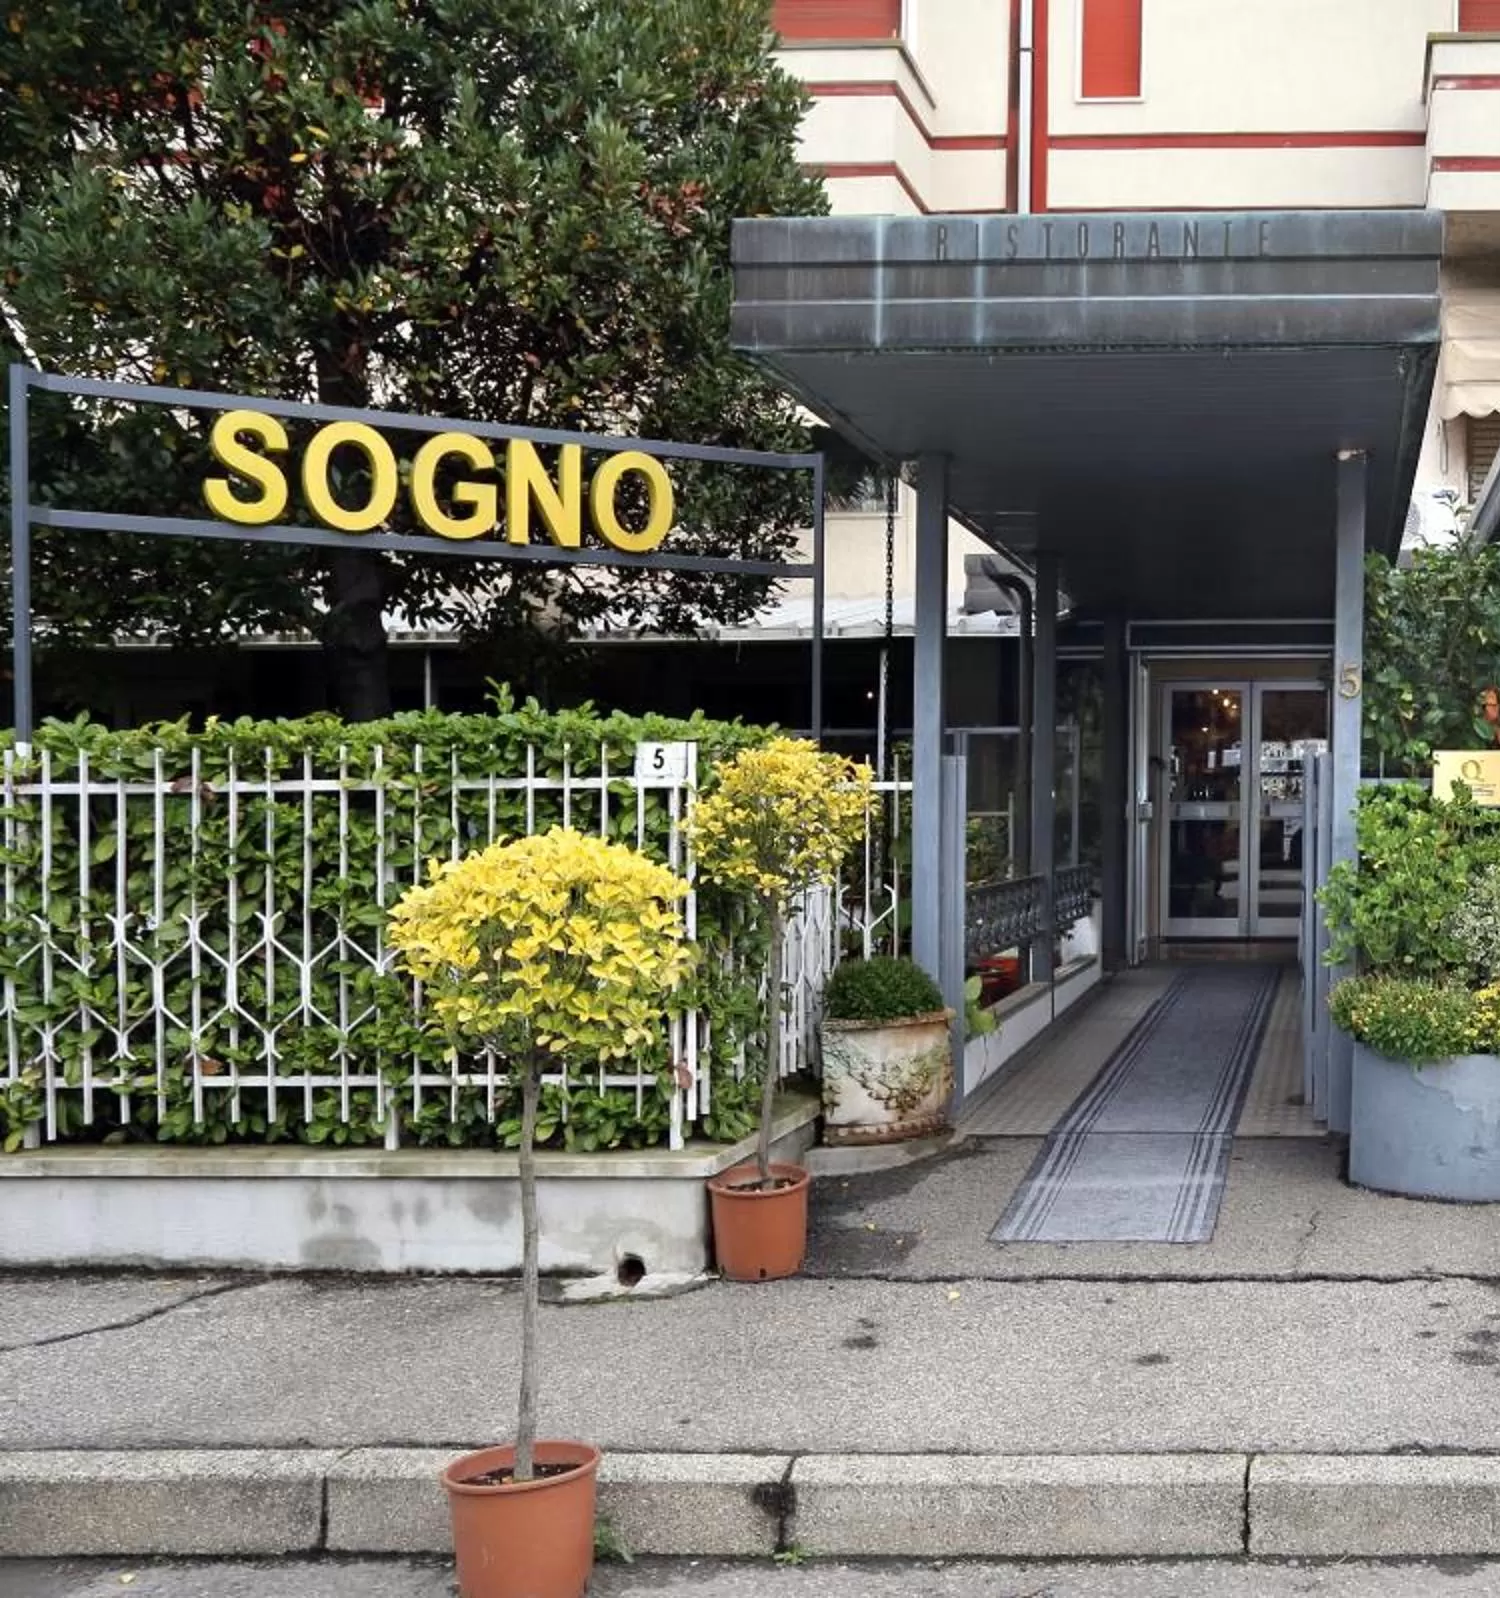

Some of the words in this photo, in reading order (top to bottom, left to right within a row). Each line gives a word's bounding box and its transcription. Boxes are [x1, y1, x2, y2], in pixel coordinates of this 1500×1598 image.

[935, 221, 1272, 260] RISTORANTE
[203, 409, 675, 554] SOGNO
[1339, 663, 1361, 699] 5
[652, 747, 665, 770] 5
[1461, 759, 1485, 782] Q
